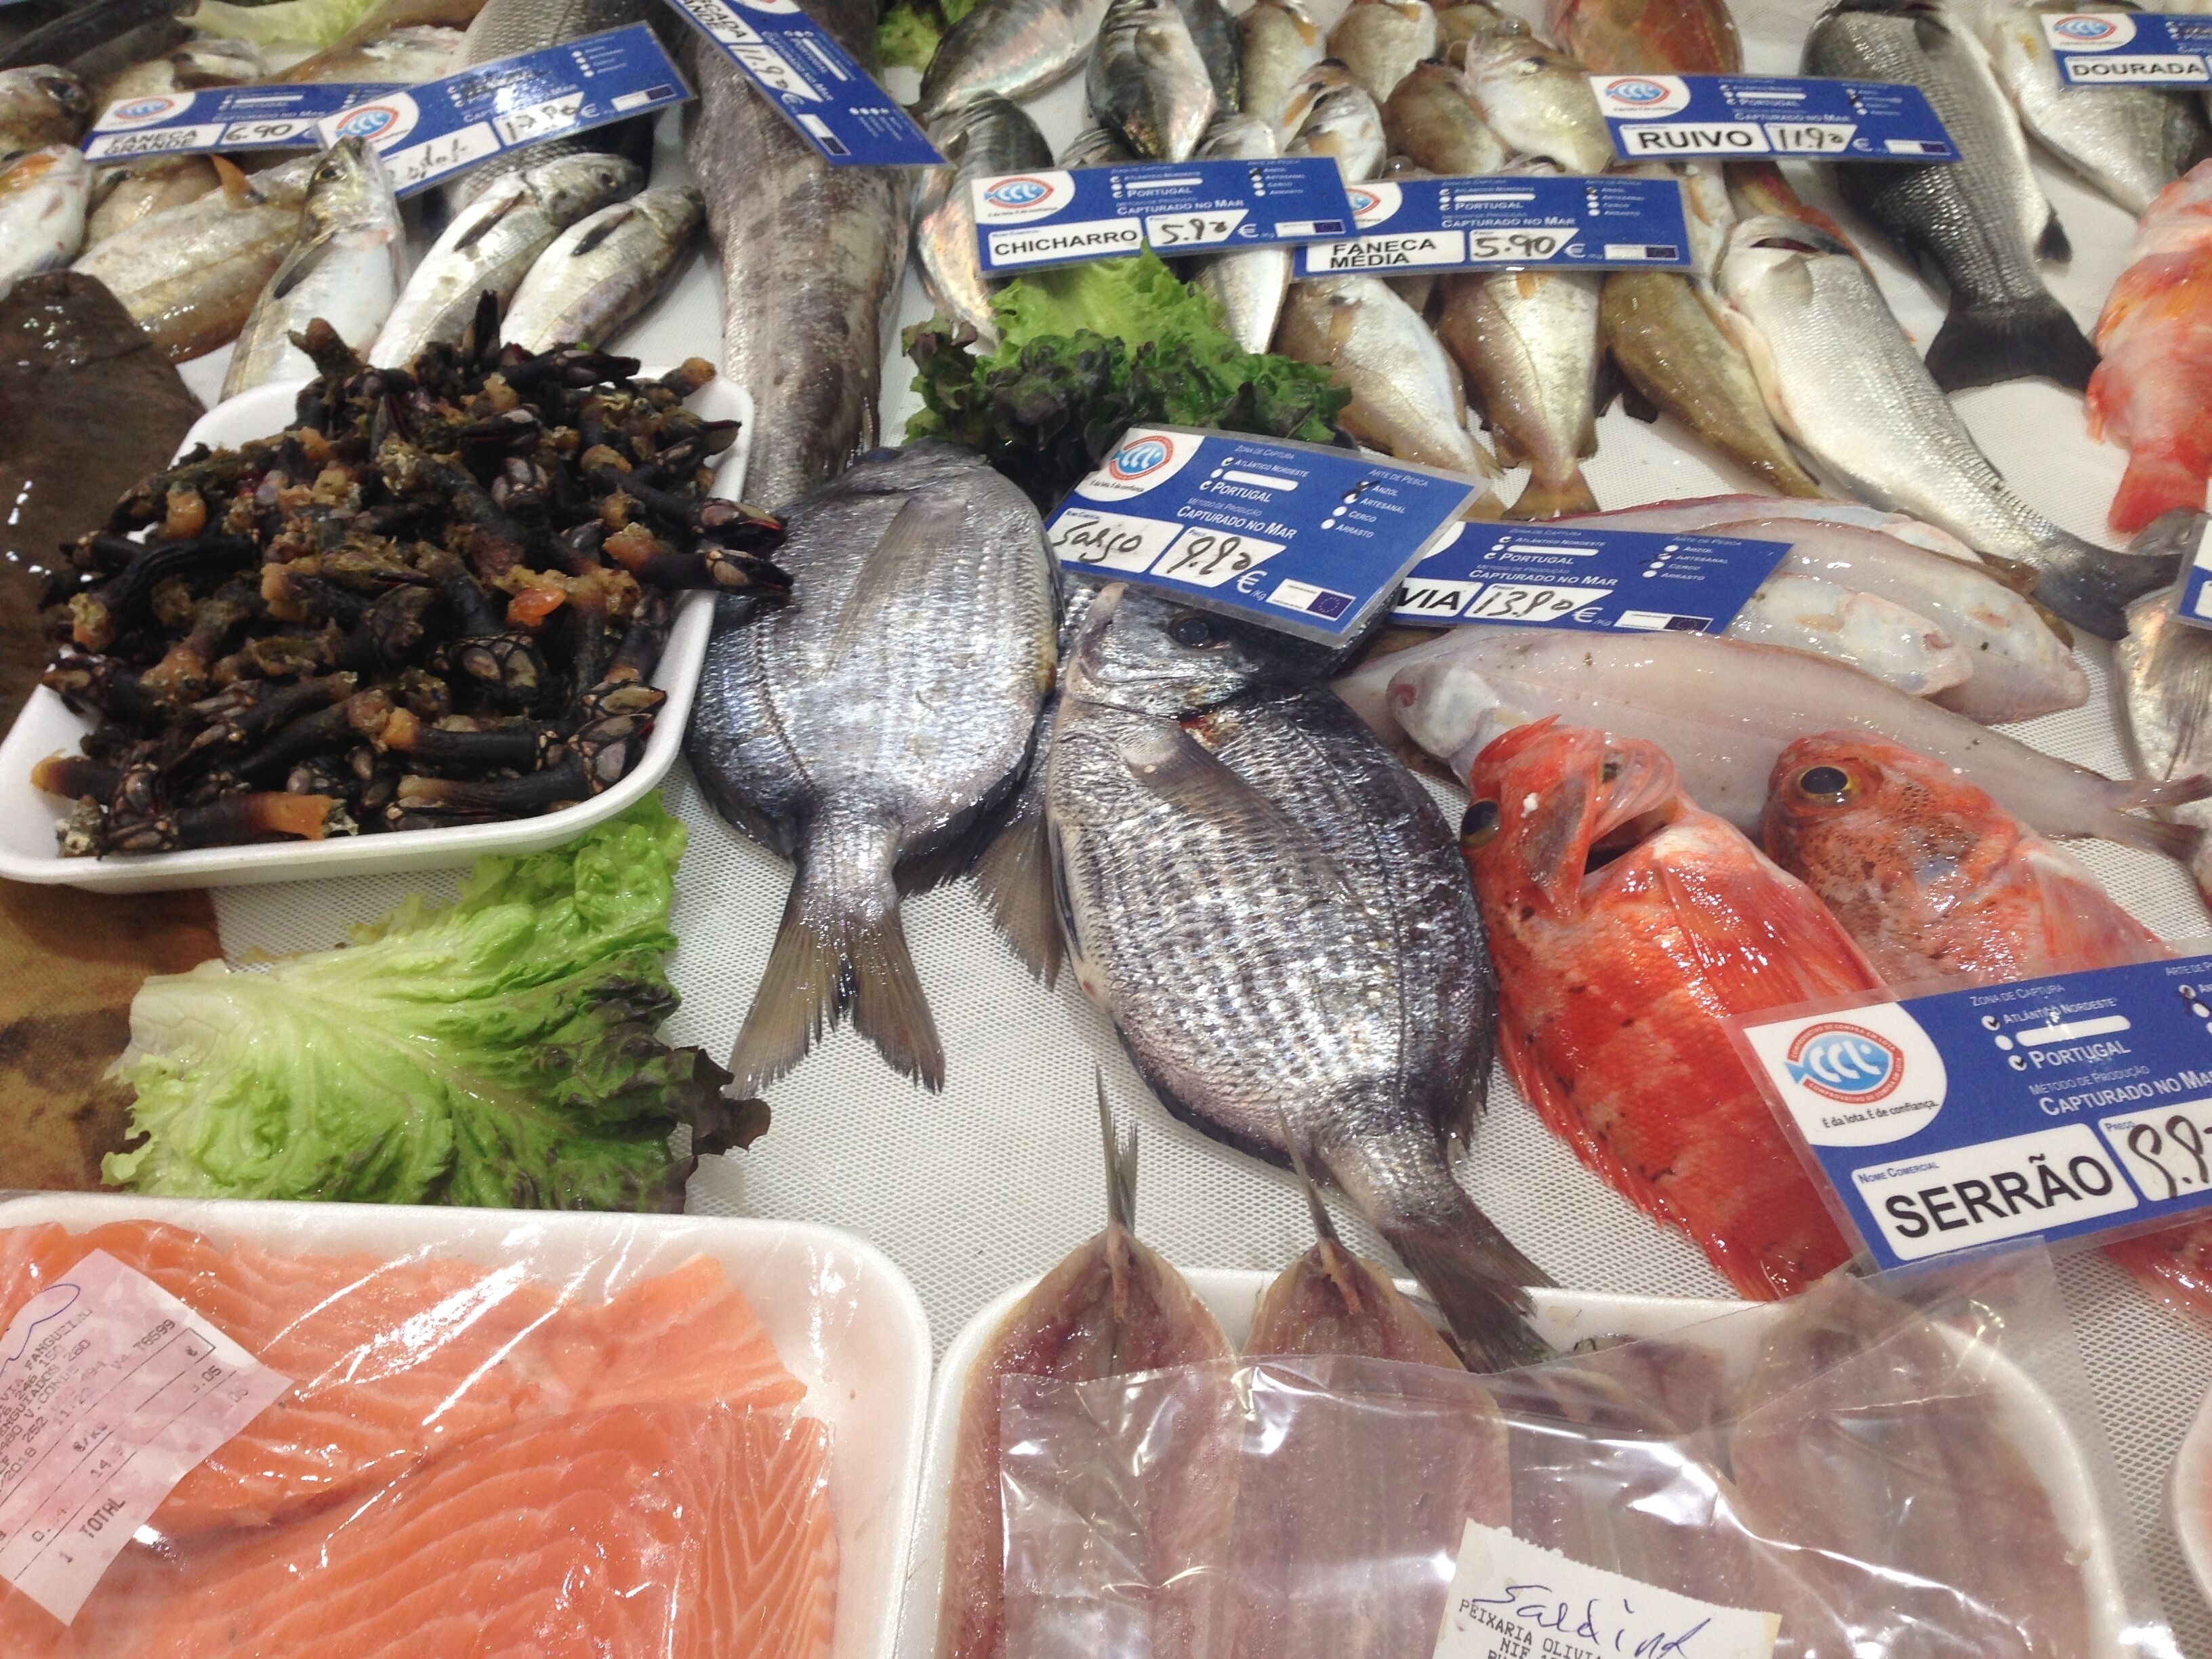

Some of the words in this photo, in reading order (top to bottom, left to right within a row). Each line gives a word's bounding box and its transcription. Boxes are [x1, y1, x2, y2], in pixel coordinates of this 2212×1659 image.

[2072, 62, 2203, 76] DOURADA
[1638, 130, 1753, 149] RUIVO
[1127, 187, 1193, 198] PORTUGAL
[1117, 203, 1193, 216] CAPTURADO
[1195, 201, 1212, 209] NO
[1214, 199, 1244, 207] MAR
[1455, 202, 1524, 211] PORTUGAL
[1441, 218, 1521, 228] CAPTURADO
[1544, 216, 1576, 226] MAR
[994, 230, 1138, 255] CHICHARRO
[1333, 239, 1437, 255] FANECA
[1473, 234, 1556, 258] 5.90
[1330, 251, 1410, 268] MÉDIA
[1210, 481, 1273, 503] PORTUGAL
[1371, 485, 1400, 497] ANZOL
[1359, 498, 1406, 514] ARTESANAL
[1176, 506, 1247, 527] CAPTURADO
[1245, 518, 1265, 532] NO
[1264, 522, 1298, 540] MAR
[1348, 510, 1377, 523] CERCO
[1335, 524, 1374, 539] ARRASTO
[1498, 552, 1574, 565] PORTUGAL
[1469, 569, 1555, 583] CAPTURADO
[1557, 577, 1580, 585] NO
[1581, 575, 1618, 586] MAR
[1969, 994, 2001, 1008] ZONA
[2001, 991, 2016, 1002] DE
[2015, 983, 2066, 999] CAPTURA
[2198, 982, 2212, 994] AN
[2058, 997, 2118, 1015] NORDESTE
[2028, 1040, 2132, 1069] PORTUGAL
[2076, 1075, 2093, 1086] DE
[2091, 1065, 2150, 1083] PRODUÇÃO
[2039, 1082, 2154, 1115] CAPTURADO
[2153, 1076, 2182, 1094] NO
[1831, 1116, 1845, 1126] da
[1875, 1107, 1889, 1118] de
[2127, 1115, 2212, 1199] 9.9
[1858, 1170, 1886, 1184] NOME
[1886, 1162, 1939, 1180] COMERCIAL
[1885, 1153, 2114, 1239] SERRÃO
[22, 1416, 48, 1444] 252
[77, 1497, 127, 1539] TOTAL
[1458, 1598, 1534, 1645] PEIXARIA
[1499, 1637, 1531, 1659] NIF
